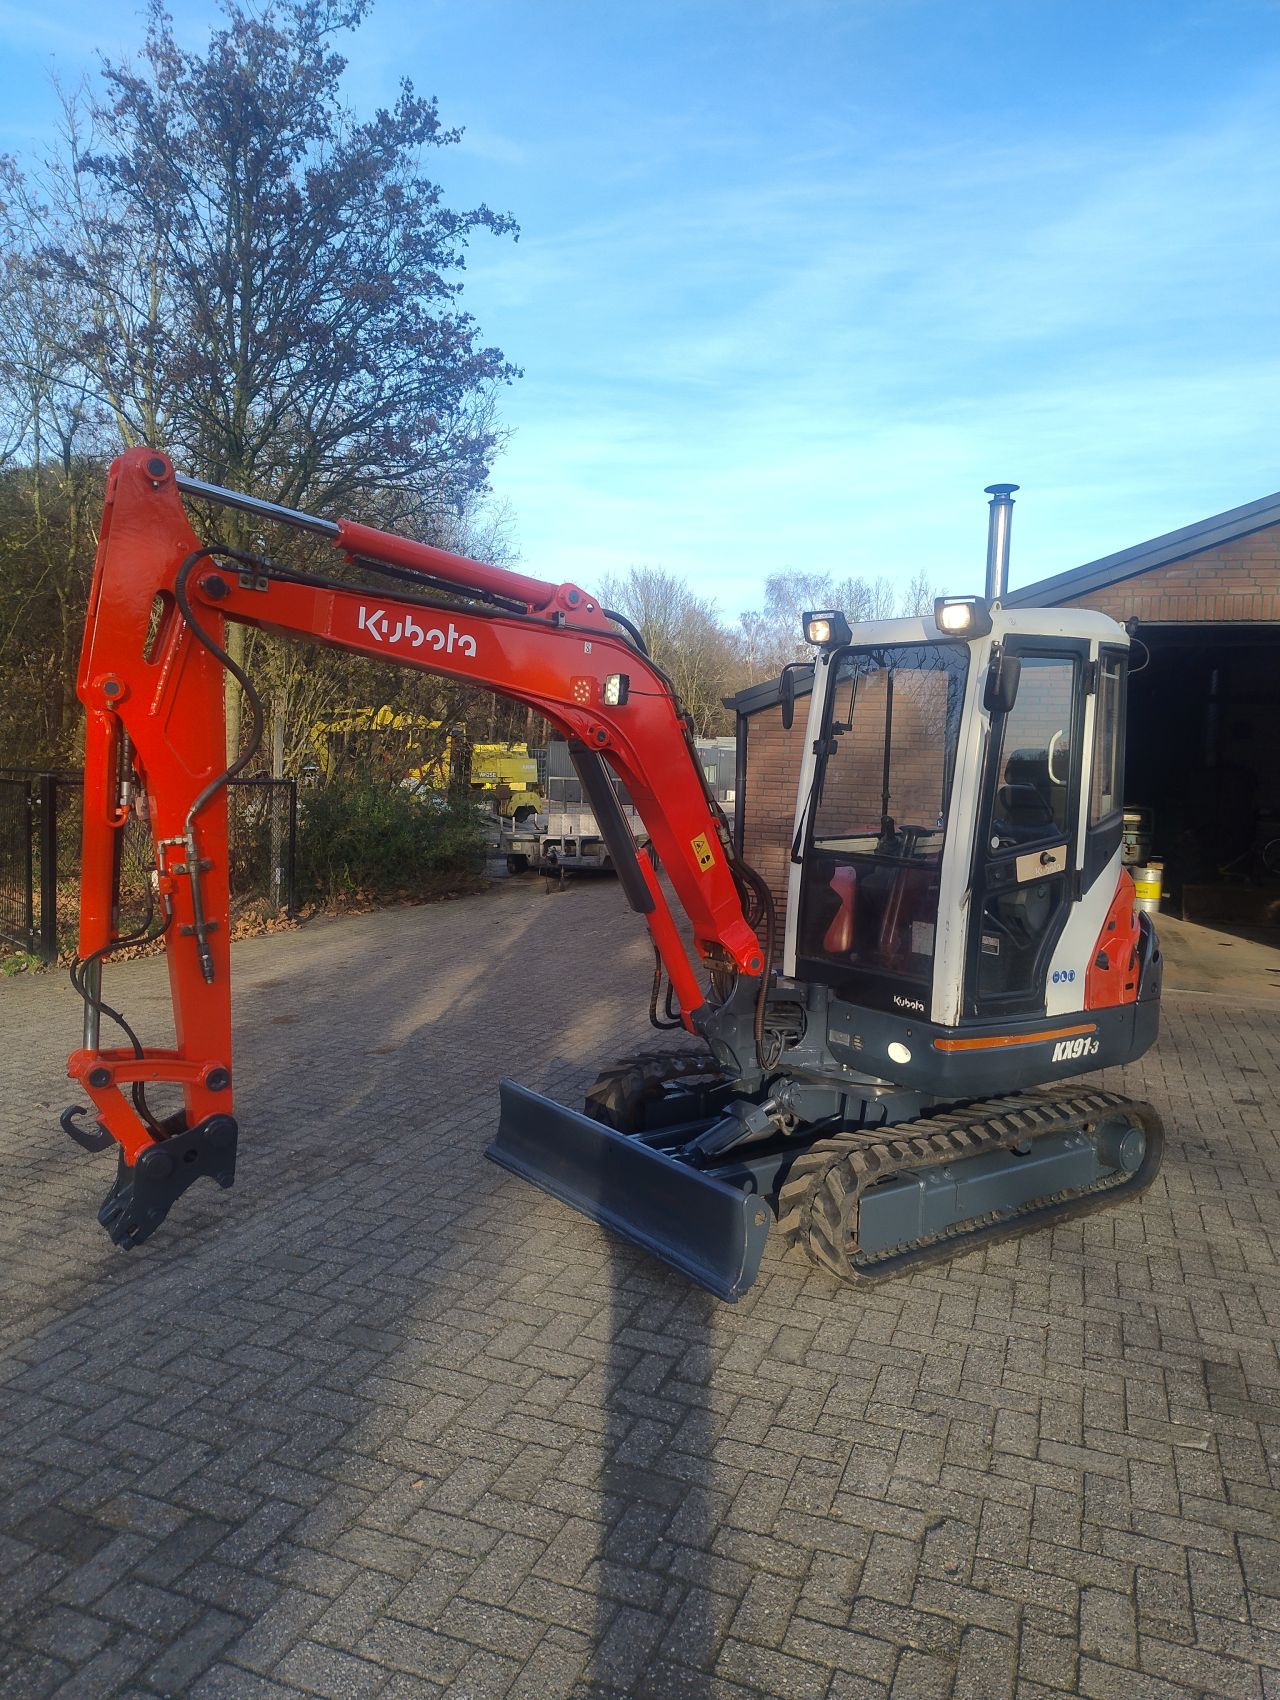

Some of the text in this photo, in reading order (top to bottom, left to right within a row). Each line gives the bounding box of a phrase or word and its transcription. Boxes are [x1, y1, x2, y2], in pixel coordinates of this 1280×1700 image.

[358, 606, 477, 658] Kubota
[893, 995, 925, 1012] Kubota
[1051, 1036, 1100, 1063] KX91-3
